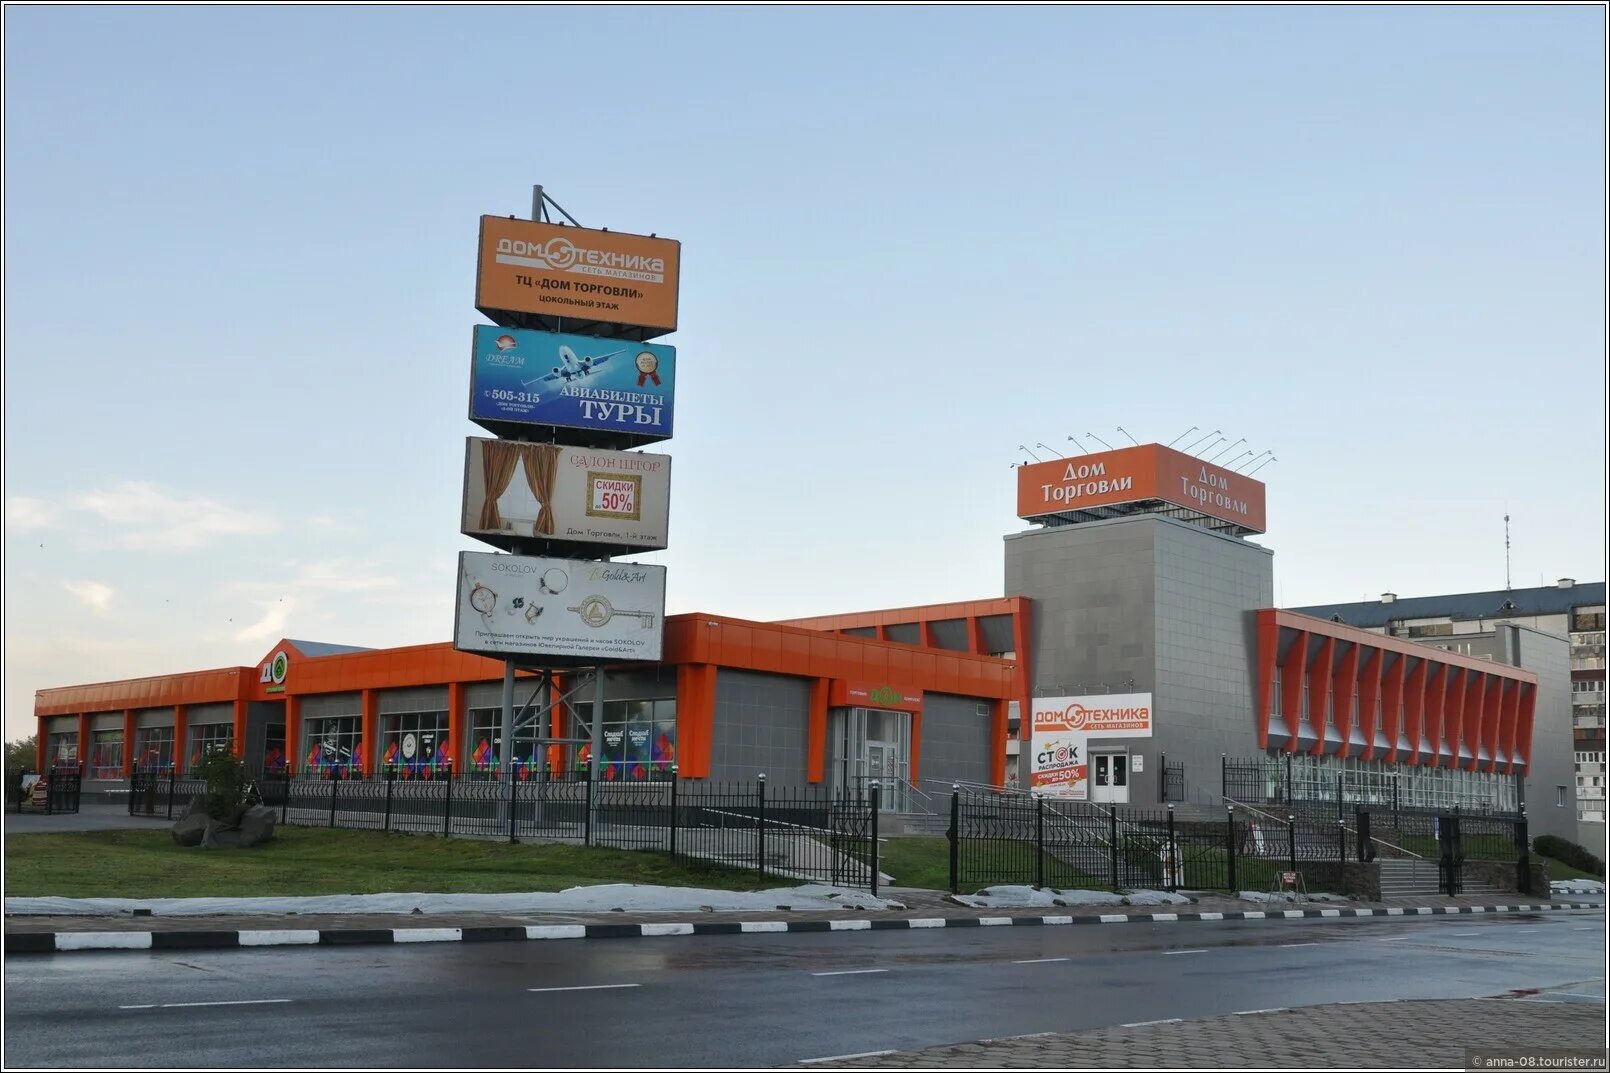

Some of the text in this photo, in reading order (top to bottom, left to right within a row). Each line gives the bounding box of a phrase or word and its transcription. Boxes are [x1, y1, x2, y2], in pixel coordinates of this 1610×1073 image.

[582, 266, 656, 281] СЕТЬ МАГАЗИНОВ
[515, 275, 643, 299] ТЦ «ДОМ ТОРГОВЛИ»
[539, 295, 619, 311] ЦОКОЛЬНЫЙ ЭТАЖ
[492, 389, 540, 403] 505-315
[560, 386, 664, 406] АВИАБИЛЕТЫ
[579, 400, 662, 426] ТУРЫ
[570, 454, 661, 472] САЛОН ШТОР
[1062, 462, 1107, 482] Дом
[596, 480, 634, 493] СКИДКИ
[1199, 465, 1228, 491] Дом
[1041, 476, 1133, 504] Торговли
[1181, 476, 1248, 516] Торговли
[602, 492, 633, 512] 50%
[566, 527, 583, 536] Дом
[587, 528, 623, 539] Торговли,
[491, 563, 647, 583] SOKOLOV Gold&Art
[475, 630, 514, 639] Приглашаем
[515, 633, 540, 641] открыть
[613, 638, 645, 648] SOKOLOV
[538, 642, 574, 650] Ювелирной
[576, 644, 600, 652] Галереи
[1106, 722, 1144, 730] МАГАЗИНОВ
[1037, 768, 1080, 780] СКИДКИ 50%
[1038, 760, 1079, 770] РАСПРОДАЖА
